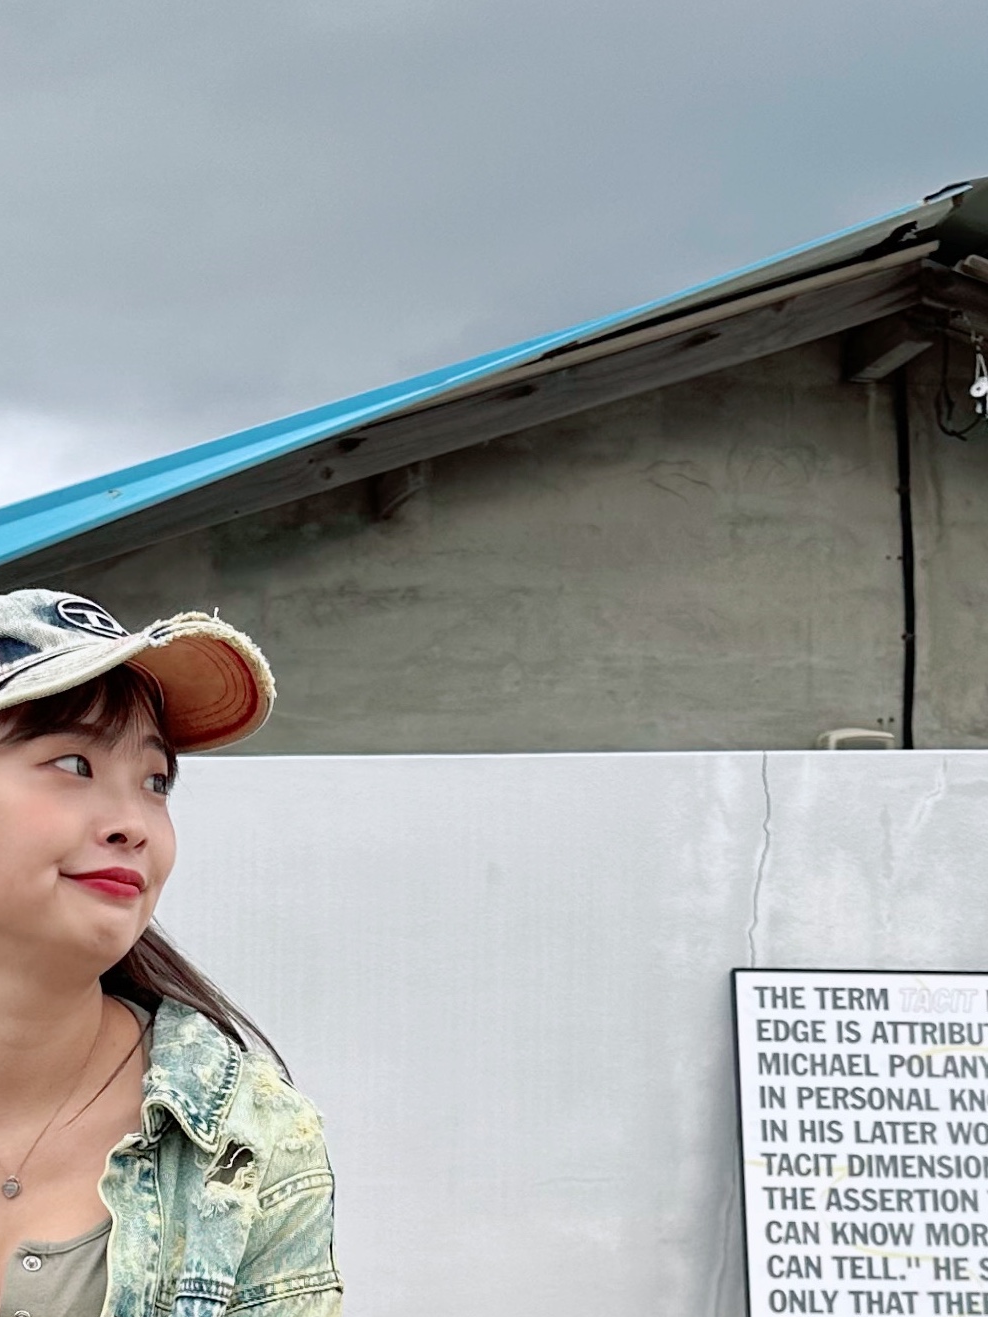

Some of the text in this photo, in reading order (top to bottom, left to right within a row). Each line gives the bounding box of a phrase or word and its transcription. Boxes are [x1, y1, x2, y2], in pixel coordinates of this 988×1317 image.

[754, 986, 805, 1009] THE
[813, 987, 888, 1010] TERM
[756, 1019, 826, 1042] EDGE
[836, 1020, 861, 1043] IS
[758, 1052, 878, 1076] MICHAEL
[759, 1085, 785, 1108] IN
[797, 1086, 939, 1111] PERSONAL
[761, 1119, 988, 1145] IN HIS LATER WO
[761, 1153, 836, 1176] TACIT
[763, 1187, 979, 1212] THE ASSERTION
[765, 1221, 988, 1247] CAN KNOW MOR
[767, 1255, 821, 1279] CAN
[832, 1256, 920, 1280] TELL."
[934, 1257, 970, 1281] HE
[769, 1289, 838, 1314] ONLY
[848, 1291, 918, 1315] THAT
